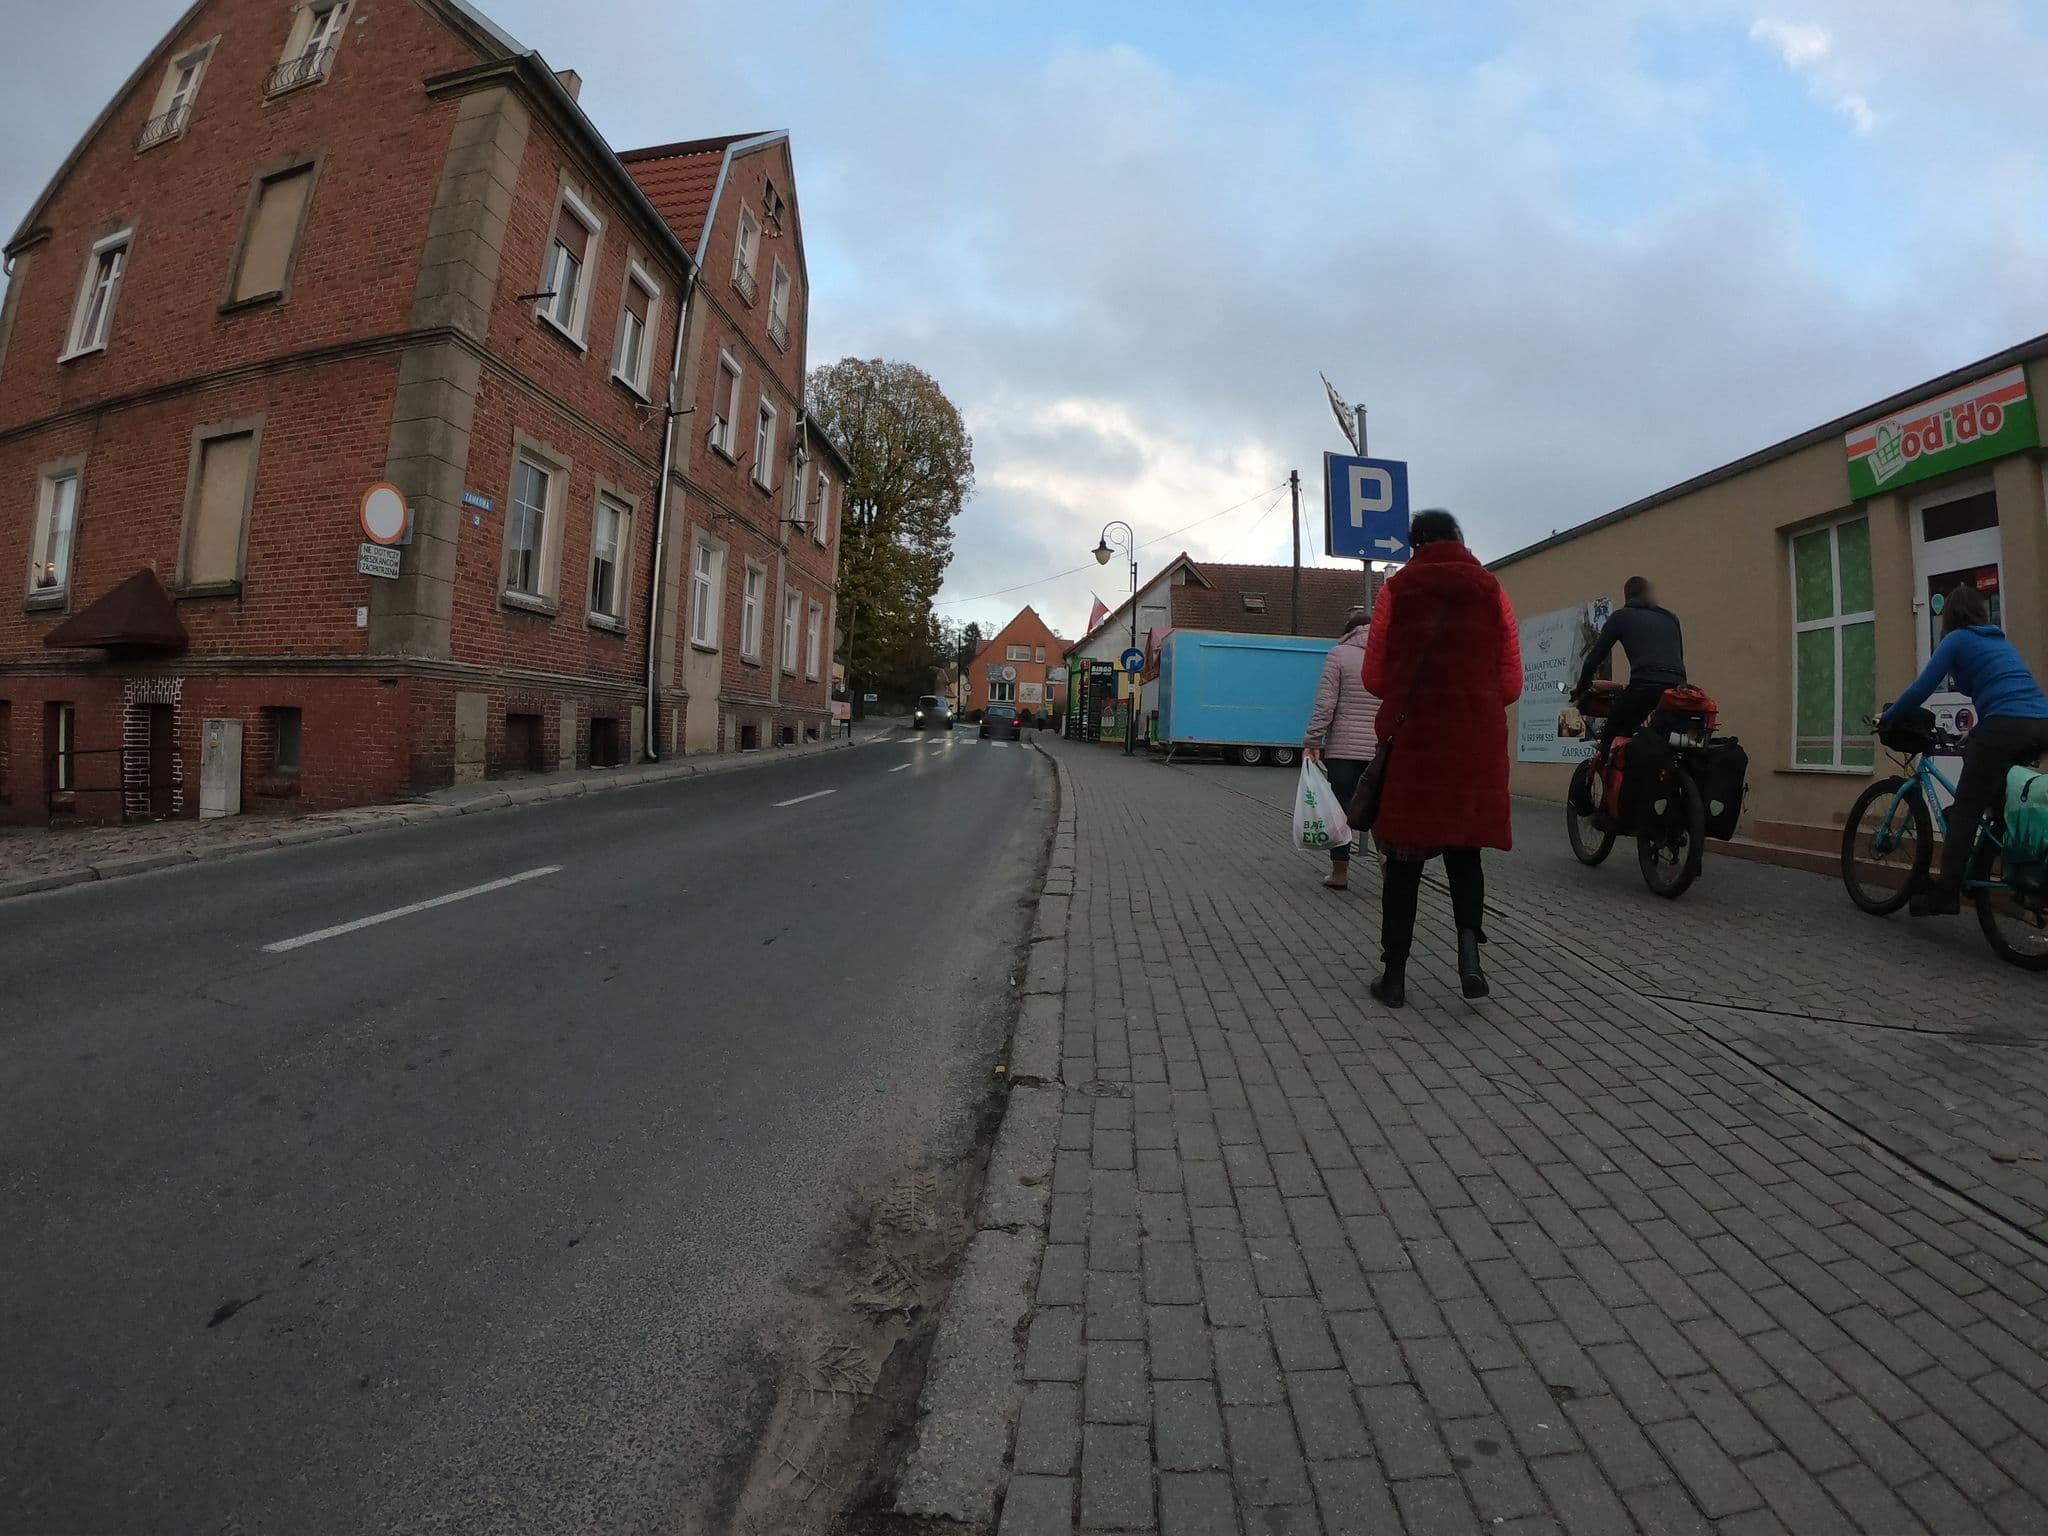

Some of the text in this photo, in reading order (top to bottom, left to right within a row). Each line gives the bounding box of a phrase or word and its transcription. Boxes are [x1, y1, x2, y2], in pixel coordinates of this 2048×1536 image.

[1901, 400, 2002, 458] odido
[1348, 465, 1393, 528] P
[363, 544, 399, 559] NIE DOTYCZY
[1525, 656, 1567, 672] KLIMATYCZNE
[1524, 671, 1547, 682] MIEJSCE
[1561, 745, 1595, 757] ZAPRASZA
[1303, 831, 1329, 844] EKO
